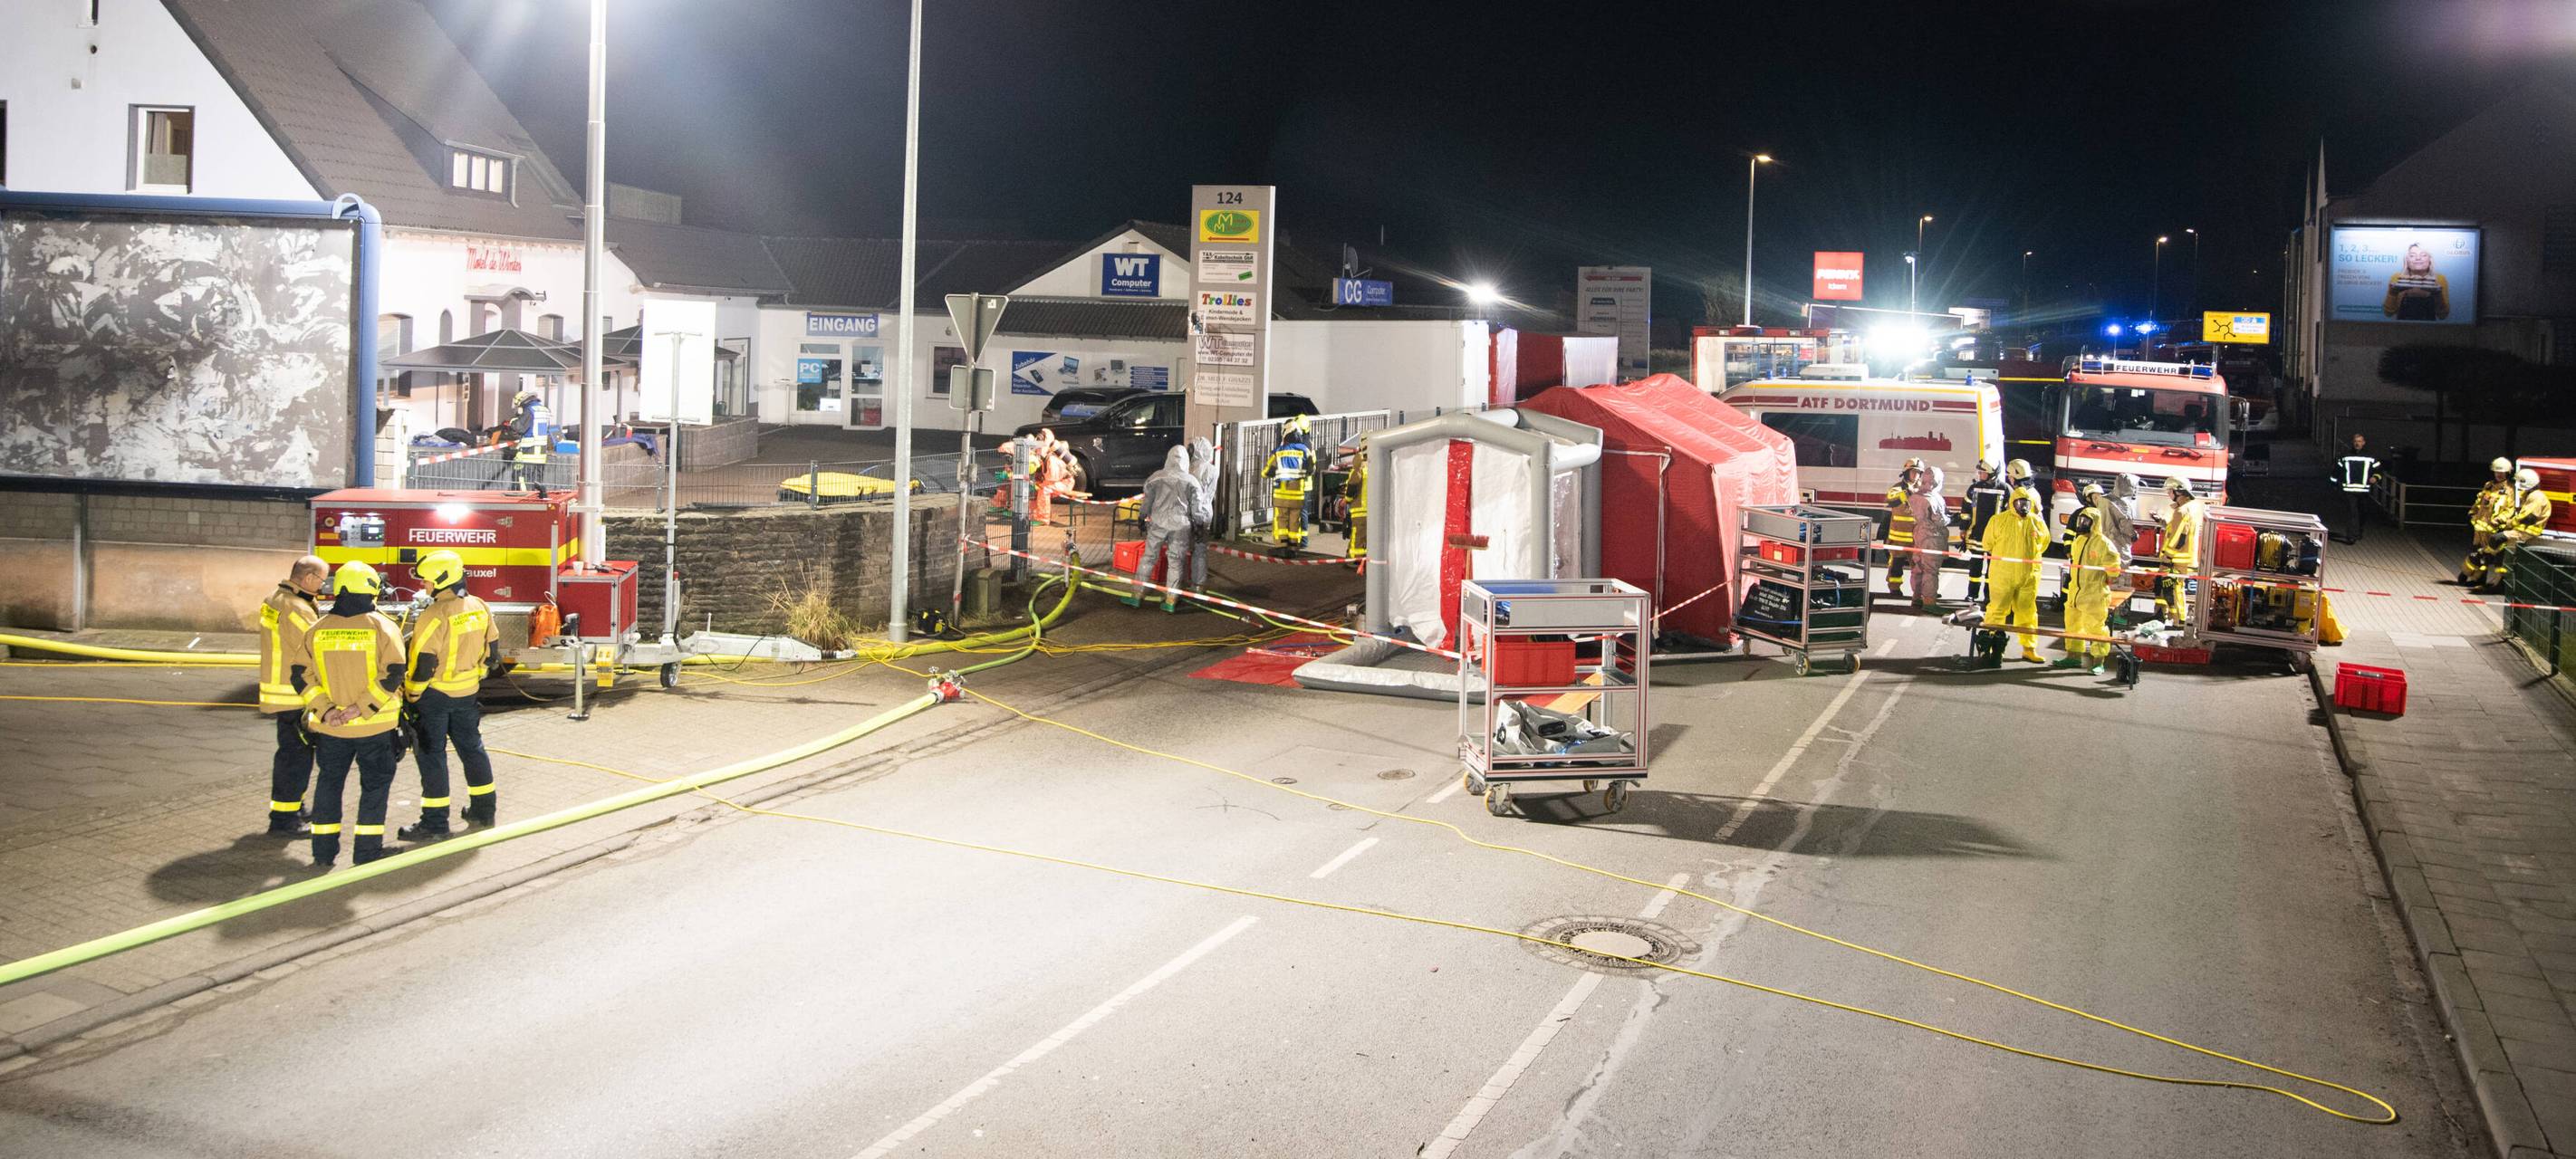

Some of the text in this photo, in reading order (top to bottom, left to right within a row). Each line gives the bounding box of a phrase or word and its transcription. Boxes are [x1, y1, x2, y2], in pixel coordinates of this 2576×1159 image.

[1217, 191, 1243, 204] 124
[2338, 254, 2398, 263] SO LECKER!
[1114, 257, 1149, 277] WT
[1111, 278, 1152, 289] Computer
[1345, 280, 1362, 303] CG
[1202, 293, 1252, 306] Trollies
[809, 317, 876, 332] EINGANG
[1197, 336, 1223, 350] WT
[800, 362, 820, 373] PC
[2116, 365, 2177, 374] FEUERWEHR
[1801, 398, 1930, 411] ATF DORTMUND
[409, 529, 496, 543] FEUERWEHR
